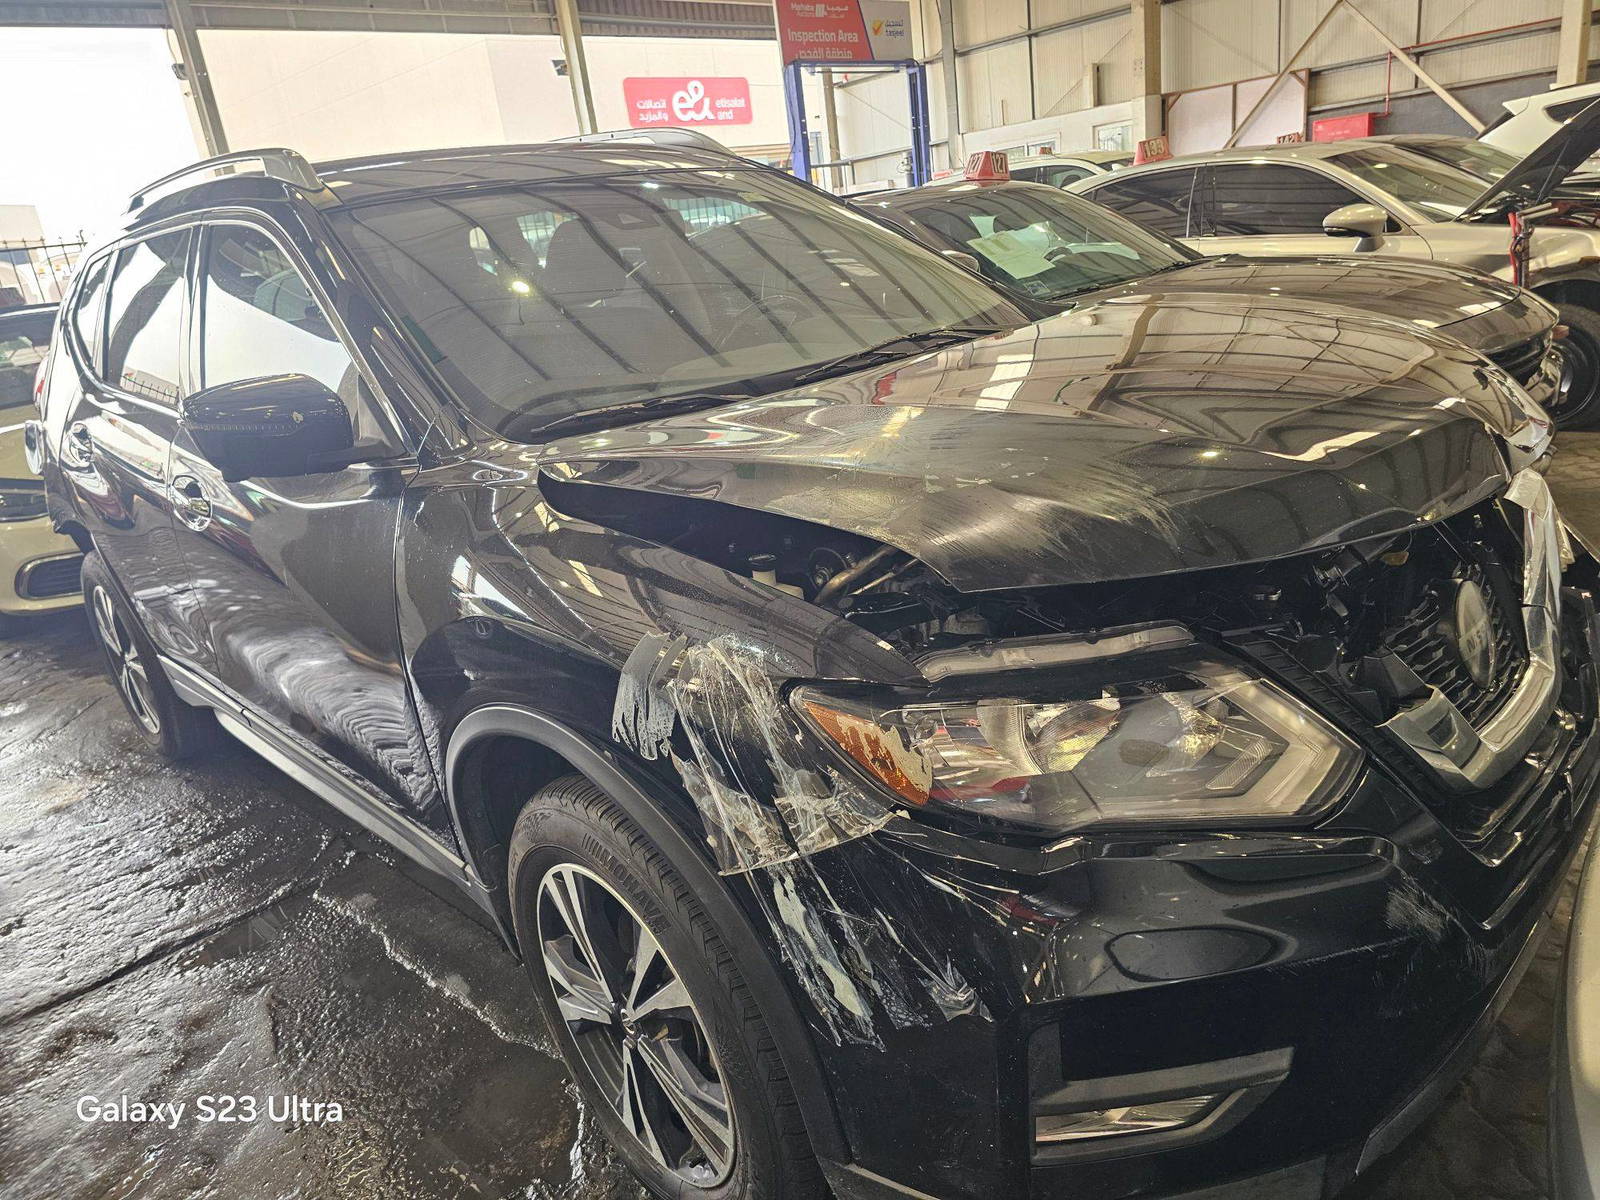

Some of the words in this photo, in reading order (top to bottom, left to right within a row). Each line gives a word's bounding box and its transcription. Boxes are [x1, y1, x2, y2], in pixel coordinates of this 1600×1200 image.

[787, 28, 837, 46] Inspection
[837, 29, 859, 43] Area
[825, 47, 853, 59] منطقة
[716, 109, 734, 121] and
[990, 152, 1007, 174] 127
